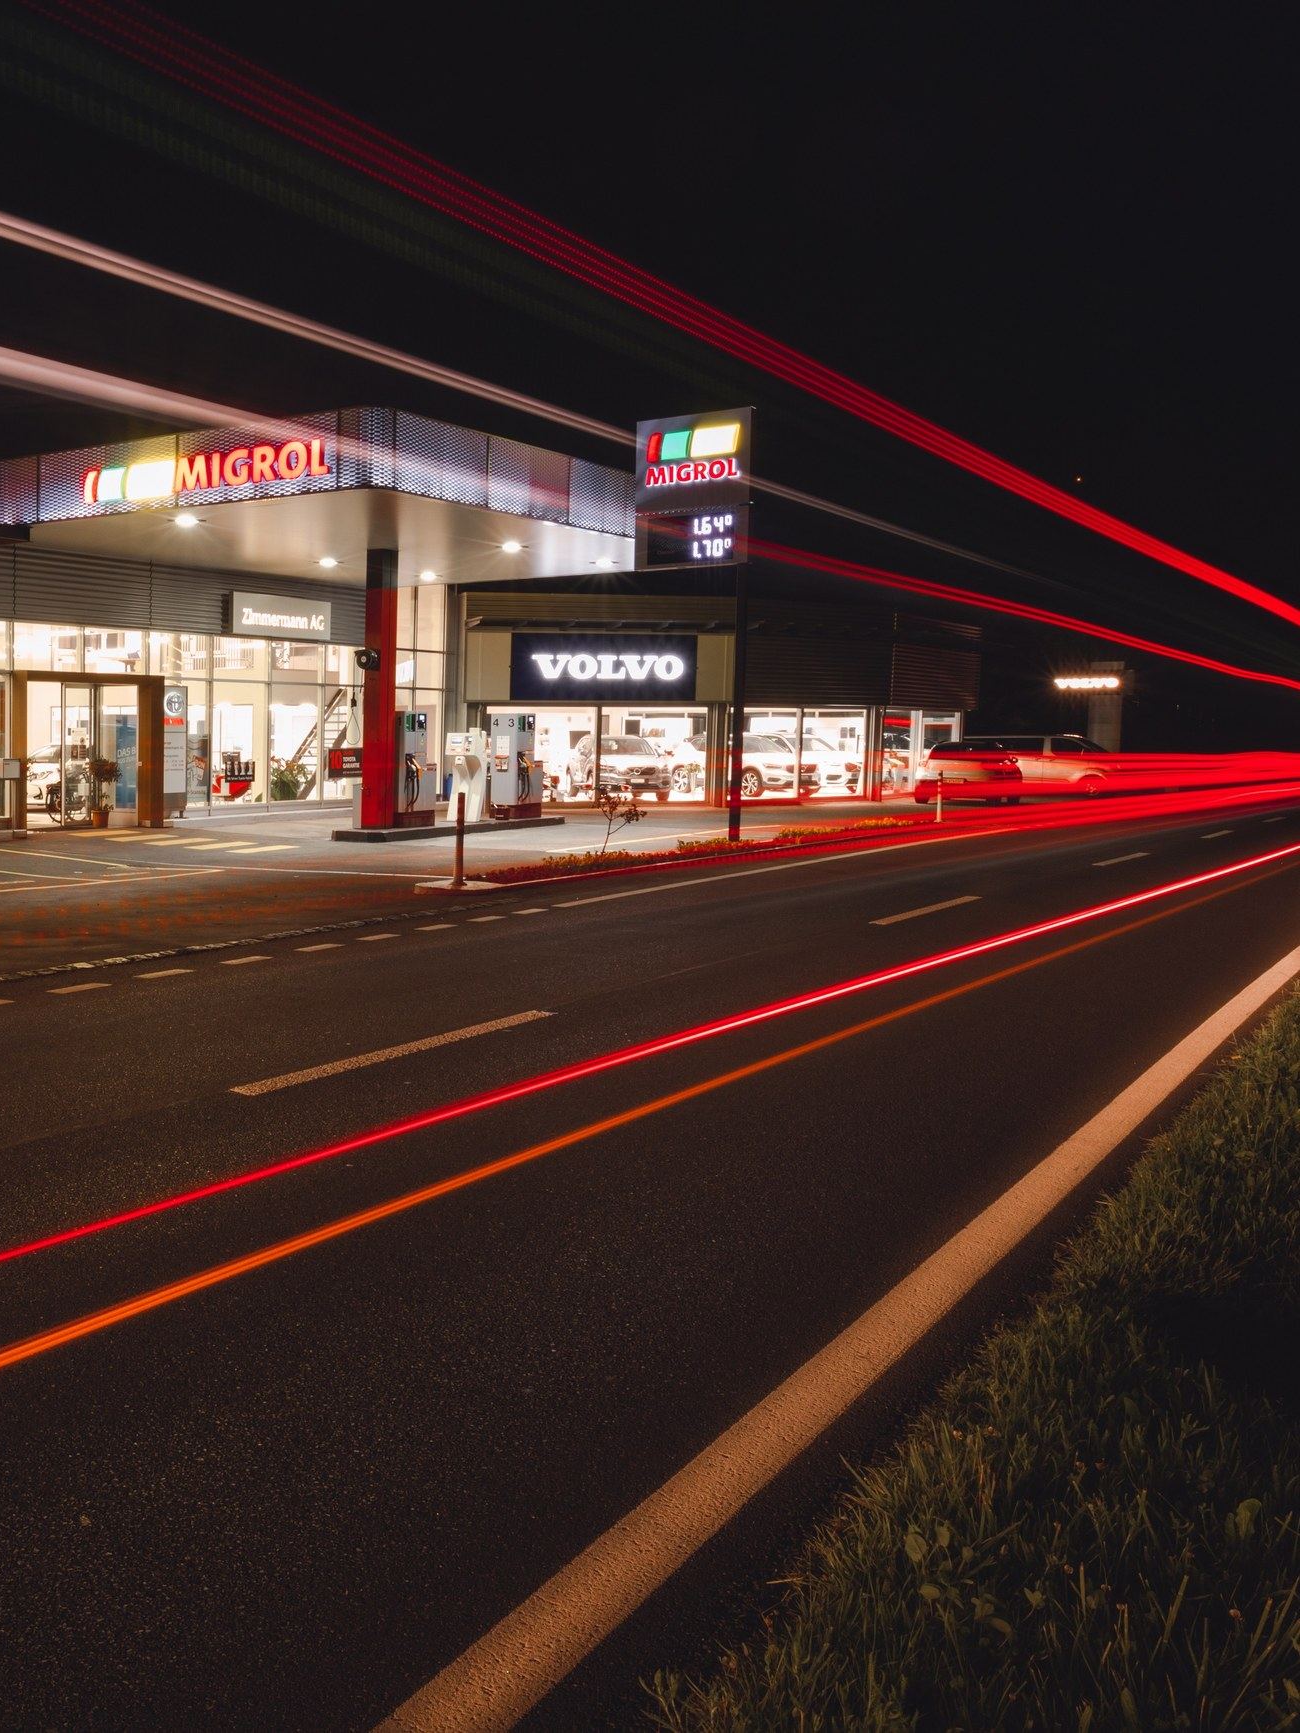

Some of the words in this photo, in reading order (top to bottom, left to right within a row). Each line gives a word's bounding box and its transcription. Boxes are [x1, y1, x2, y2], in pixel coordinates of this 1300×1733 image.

[175, 438, 330, 492] MIGROL
[645, 458, 740, 487] MIGROL
[241, 607, 308, 630] Zimmermann
[309, 614, 325, 631] AG
[531, 653, 684, 681] VOLVO
[508, 719, 515, 727] 3
[117, 747, 131, 757] DAS
[330, 751, 343, 769] 10
